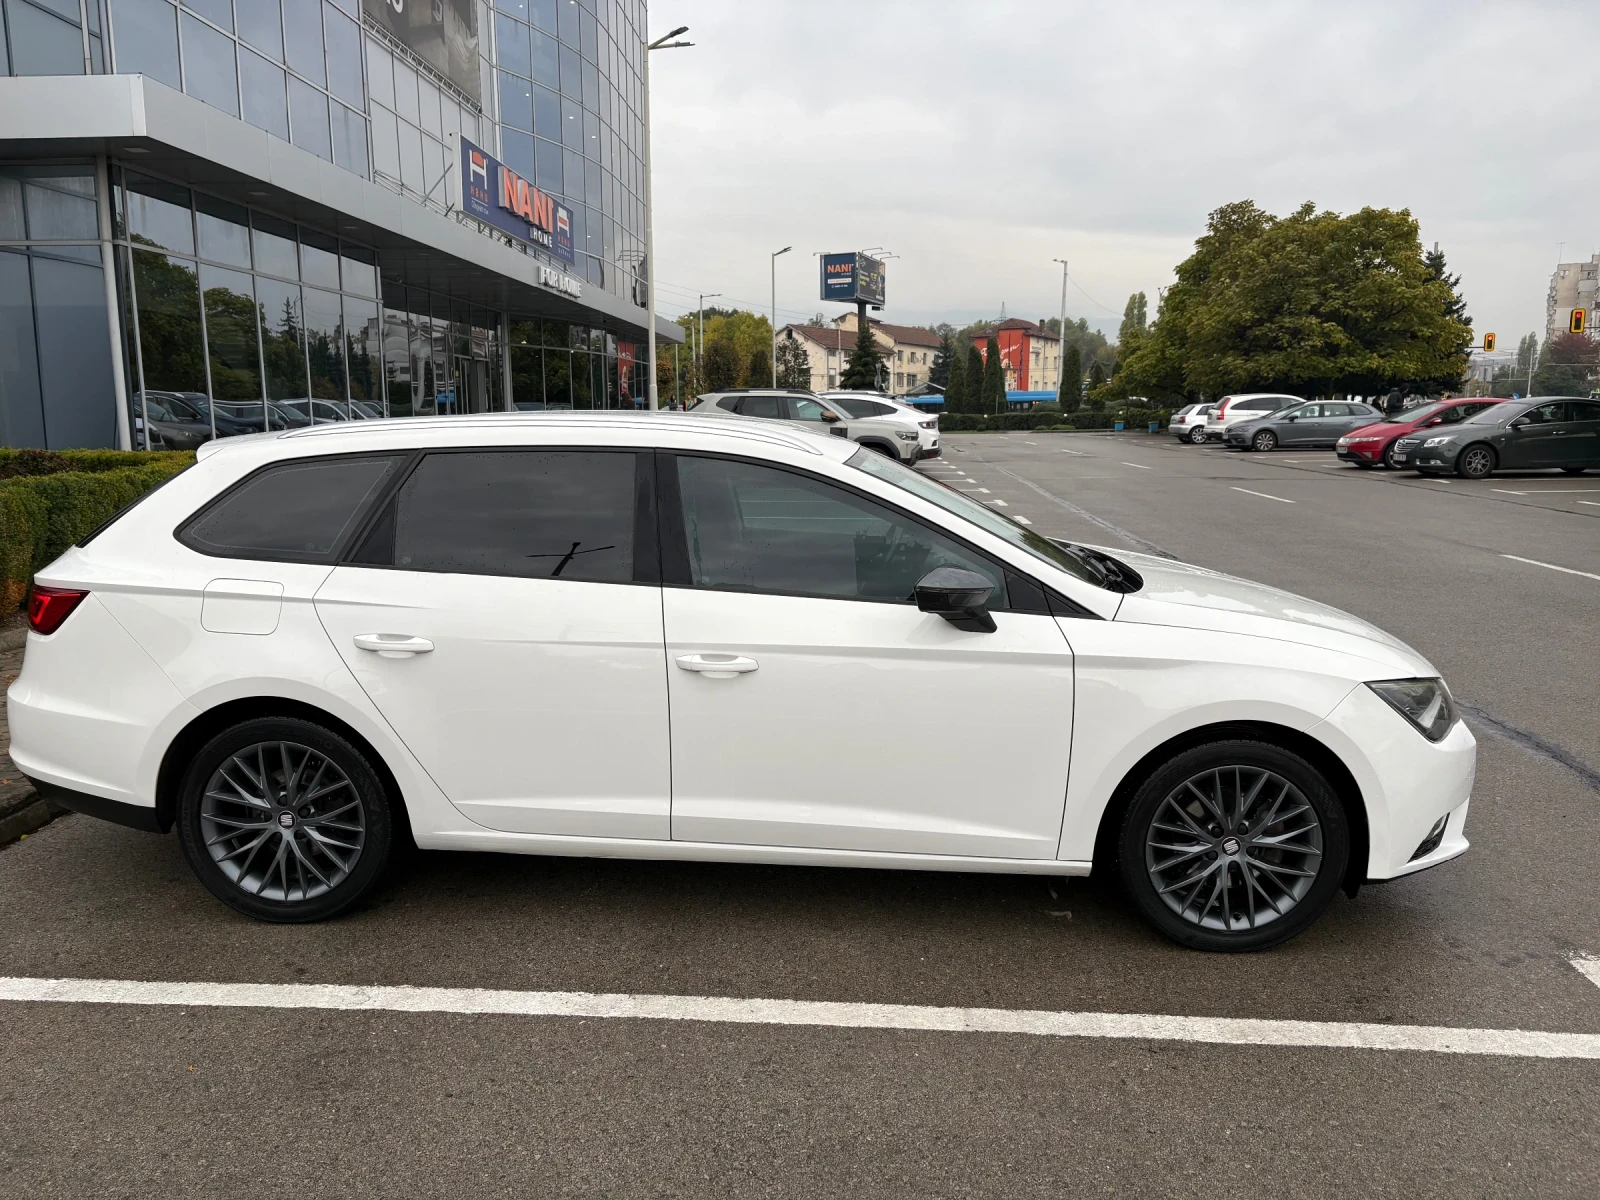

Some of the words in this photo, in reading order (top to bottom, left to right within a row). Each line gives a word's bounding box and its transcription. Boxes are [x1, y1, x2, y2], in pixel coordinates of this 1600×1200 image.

[500, 166, 553, 233] NANI
[532, 228, 553, 248] HOME
[828, 264, 852, 273] NANI
